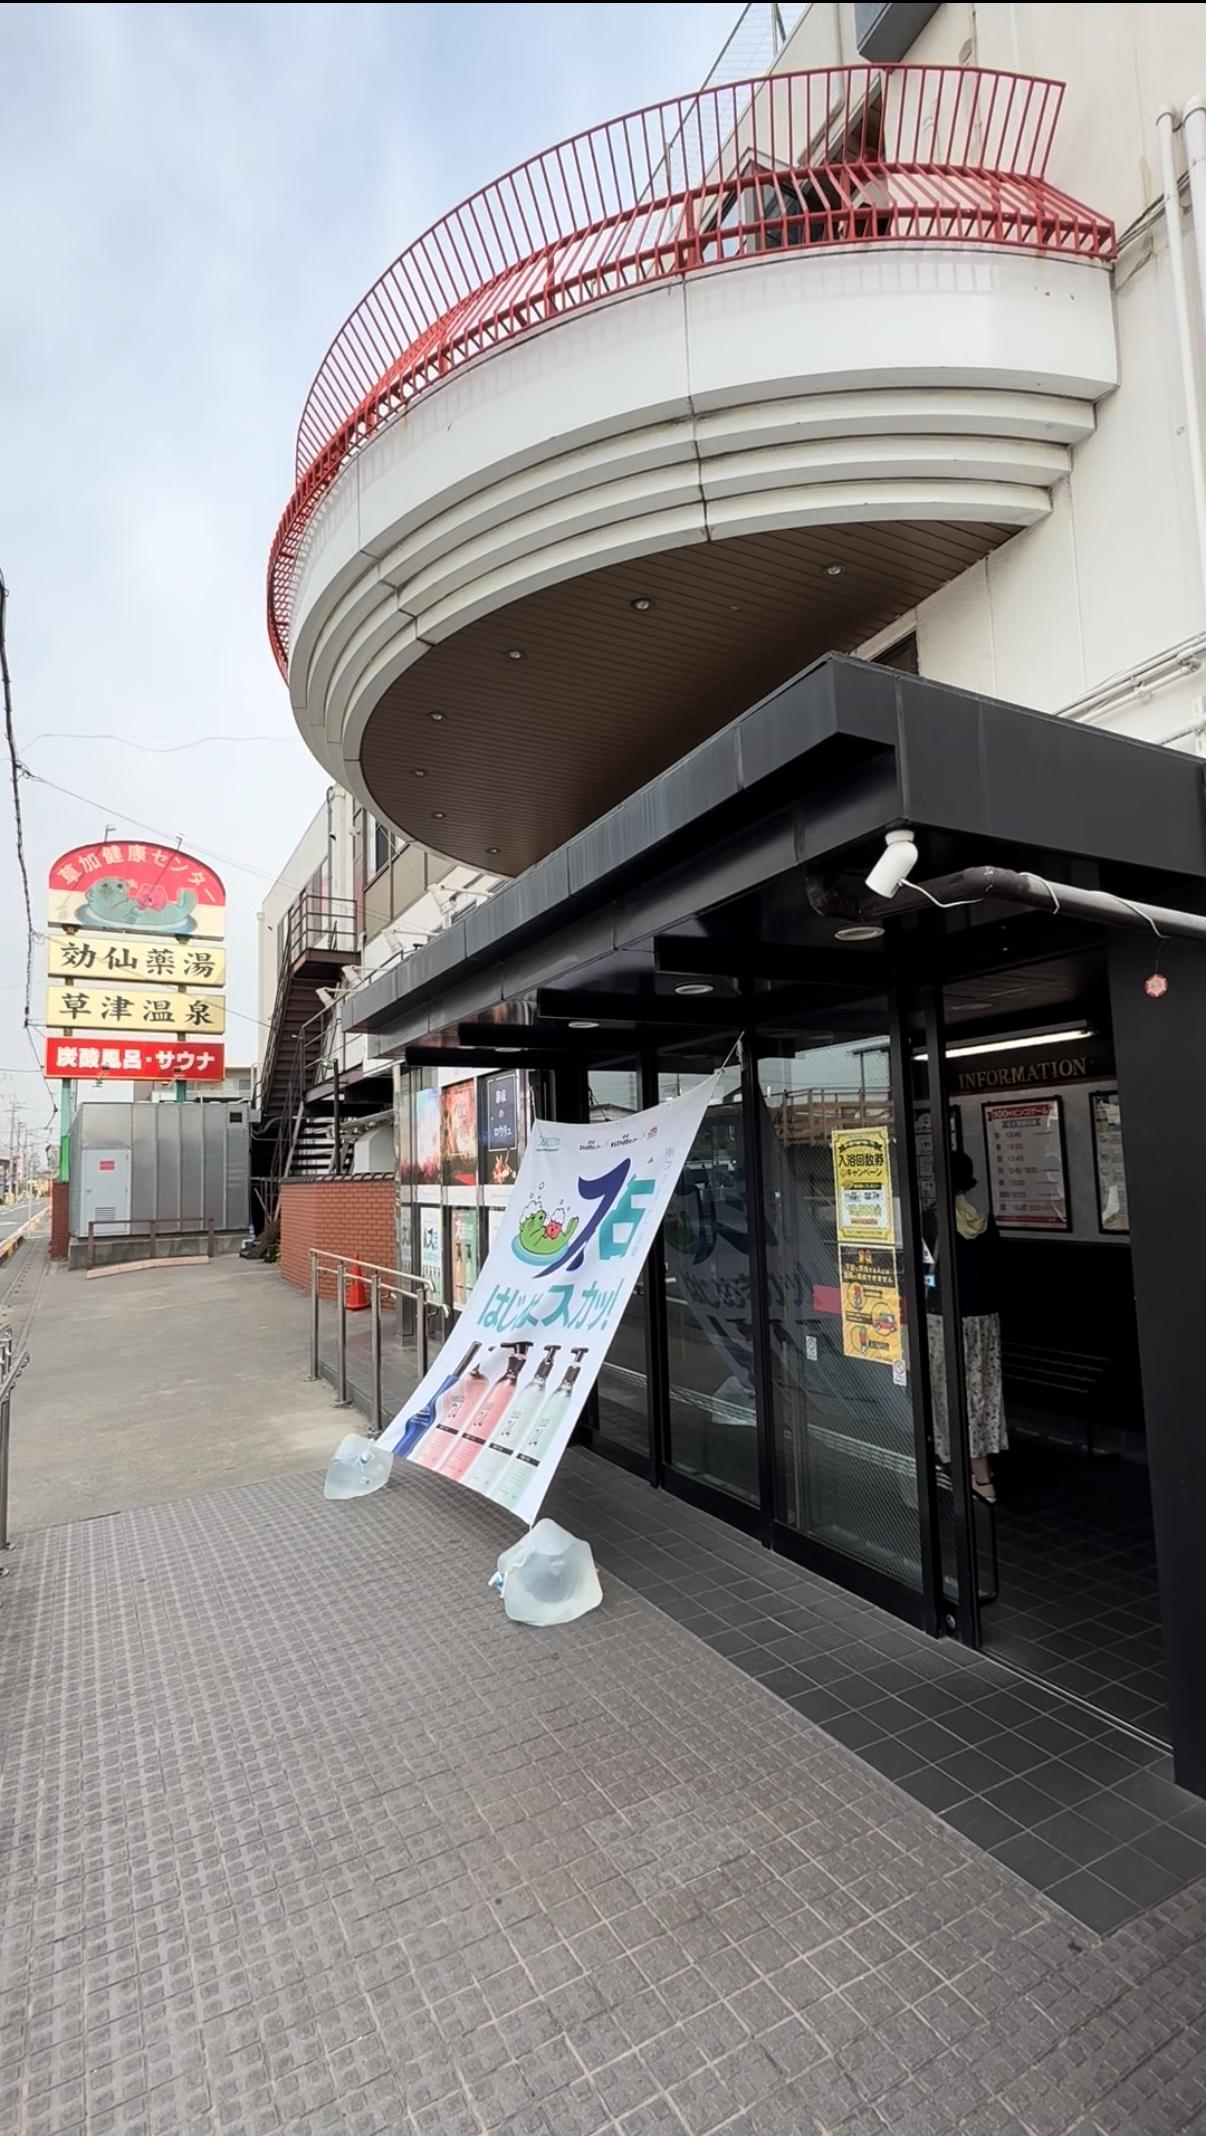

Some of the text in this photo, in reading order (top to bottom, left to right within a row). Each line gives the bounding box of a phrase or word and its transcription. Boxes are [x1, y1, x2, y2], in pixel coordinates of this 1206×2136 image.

[57, 844, 216, 903] 草加健康センター
[60, 941, 216, 979] 効仙薬湯
[58, 992, 214, 1026] 草津温泉
[56, 1046, 216, 1071] 炭酸風呂・サウナ
[958, 1057, 1087, 1090] INFORMATION
[838, 1152, 884, 1168] 入浴回数券
